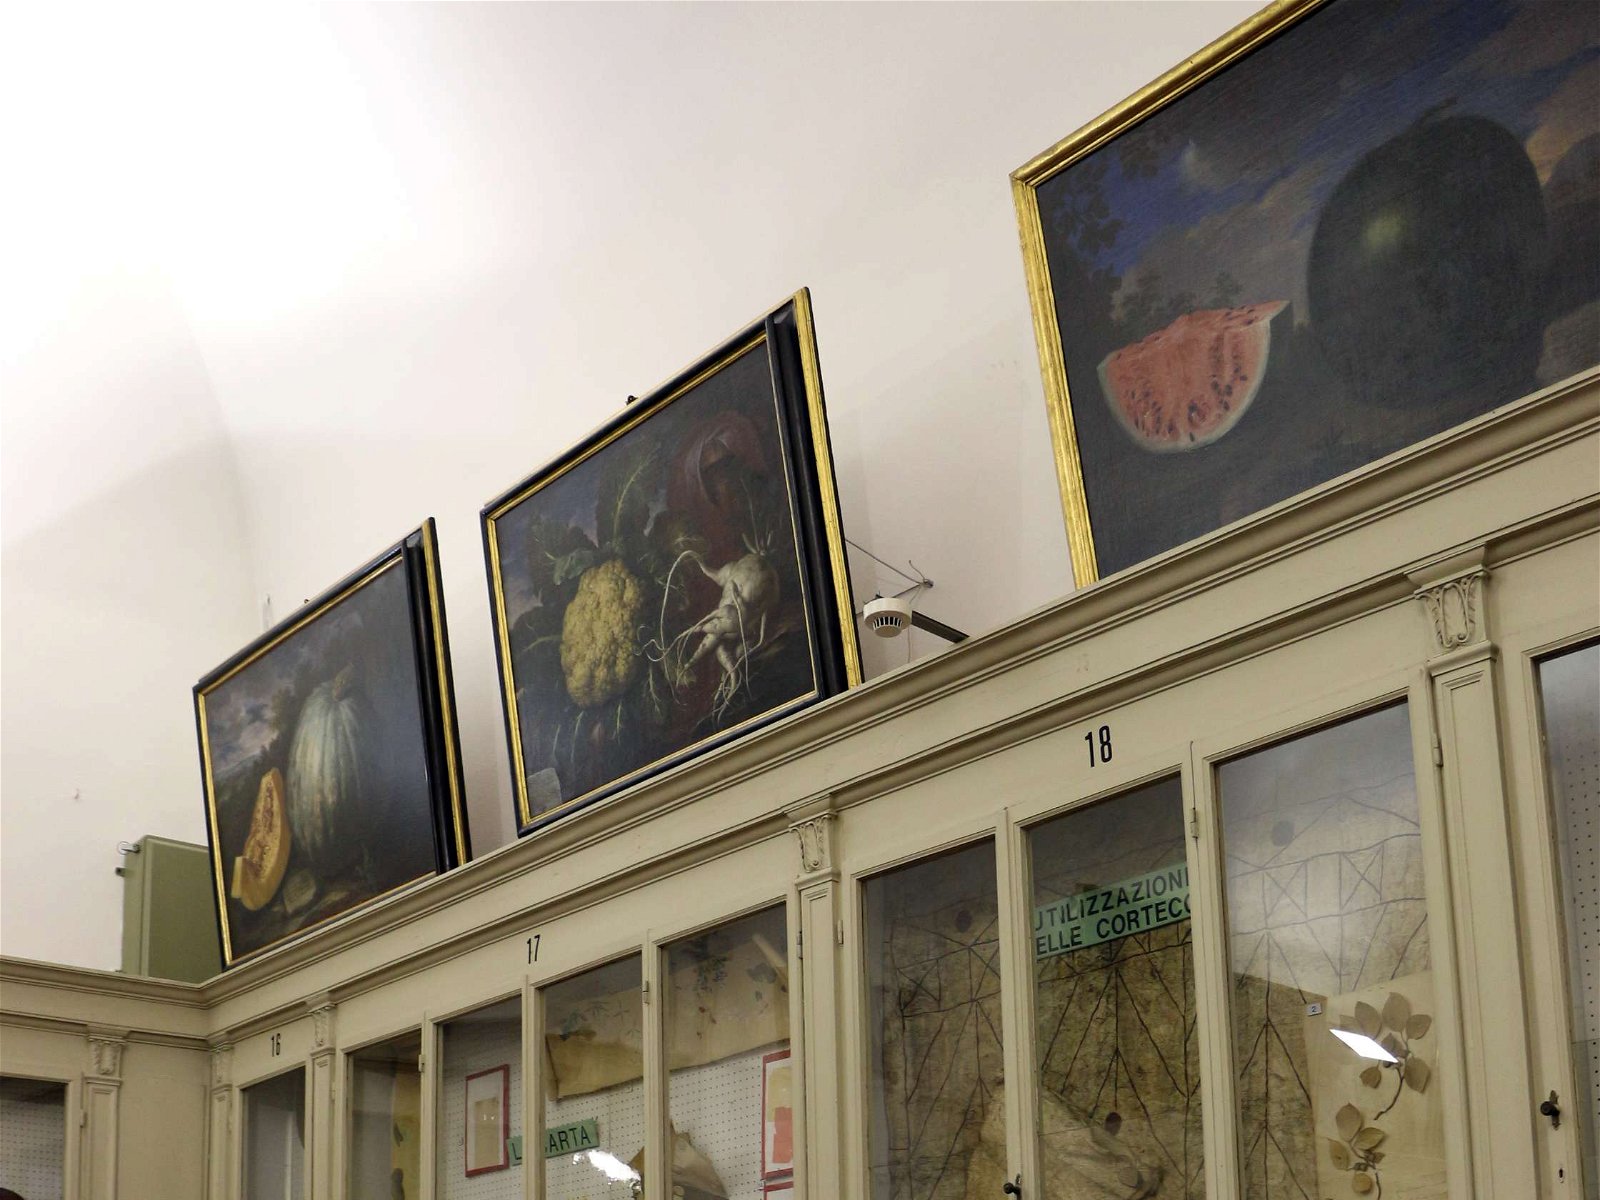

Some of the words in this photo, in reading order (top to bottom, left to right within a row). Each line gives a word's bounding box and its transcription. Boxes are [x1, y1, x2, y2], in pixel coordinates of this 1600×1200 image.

[1085, 725, 1113, 768] 18
[526, 934, 541, 964] 17
[1036, 925, 1083, 956] ELLE
[271, 1032, 281, 1057] 16
[545, 1125, 592, 1153] ARTA
